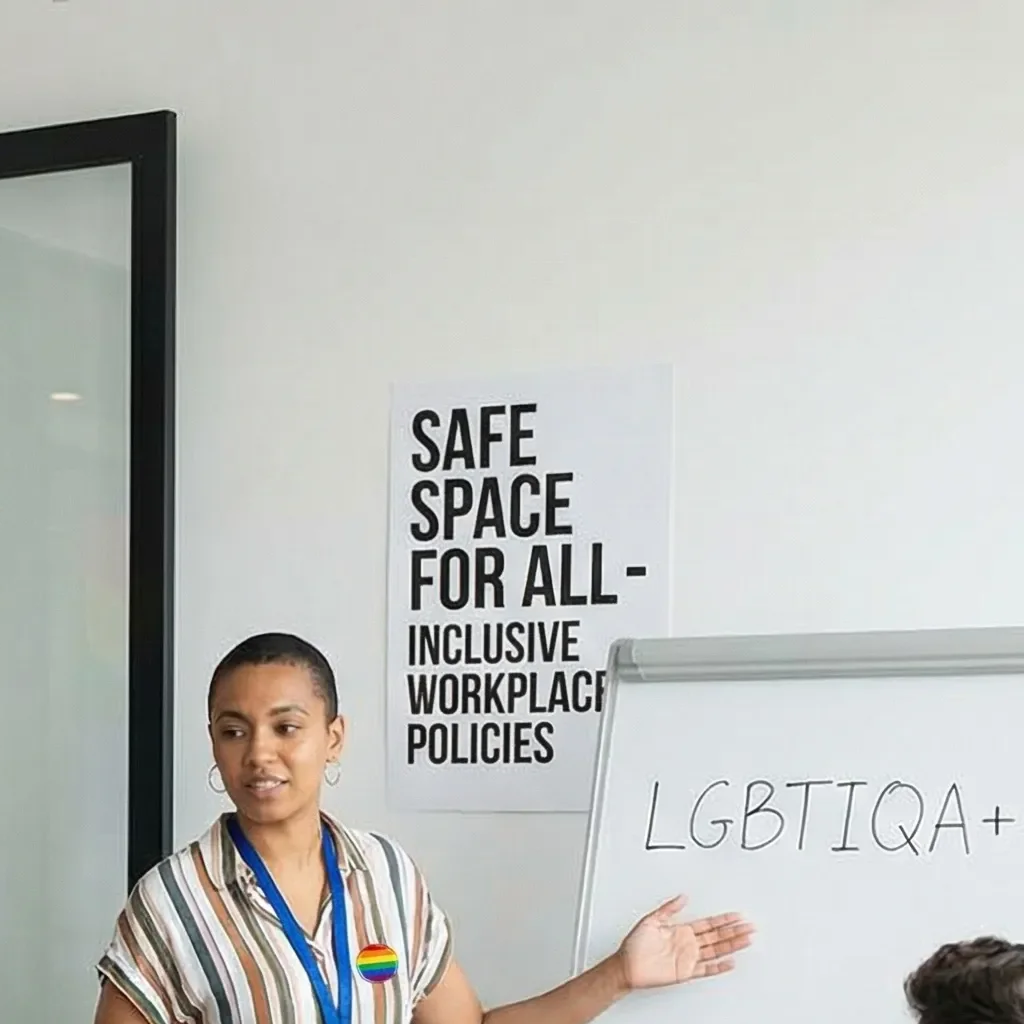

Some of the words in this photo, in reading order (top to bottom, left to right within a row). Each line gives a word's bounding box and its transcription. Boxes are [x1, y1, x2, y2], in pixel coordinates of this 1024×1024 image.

[411, 403, 538, 473] SAFE
[410, 471, 574, 542] SPACE
[411, 547, 506, 611] FOR
[408, 620, 580, 667] INCLUSIVE
[407, 721, 554, 765] POLICIES
[645, 780, 1016, 857] LGBTIQA+
